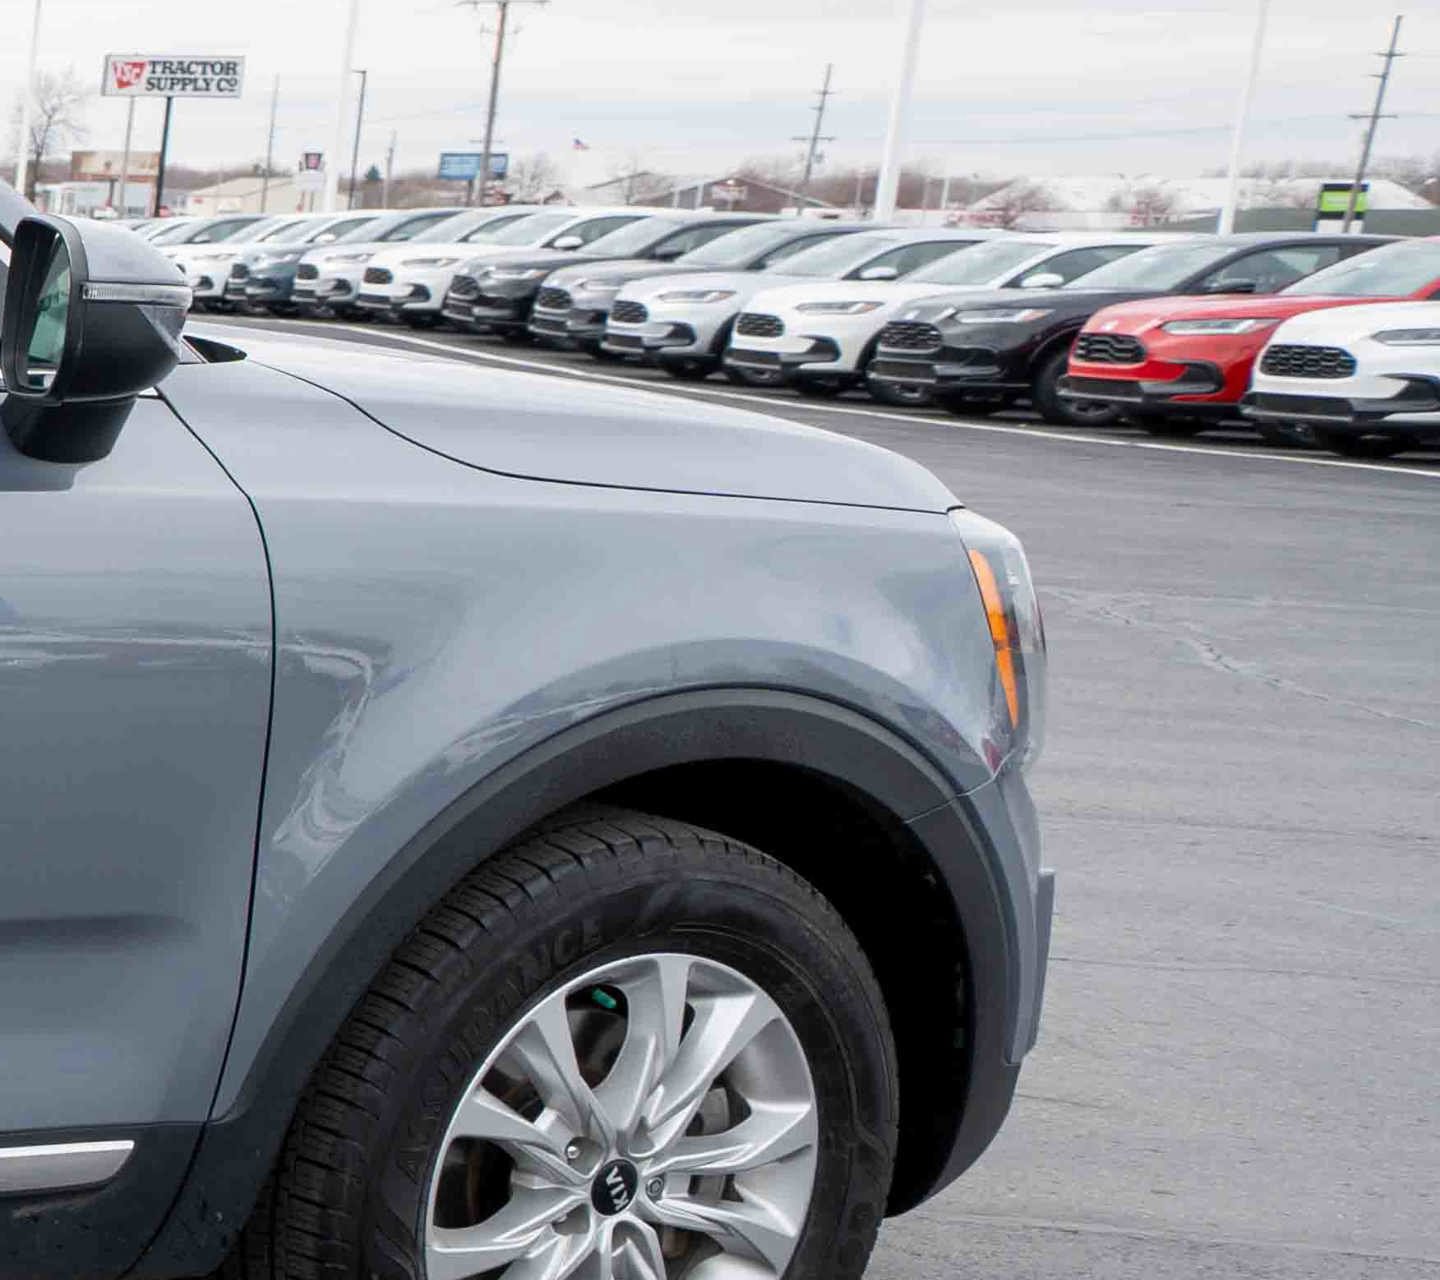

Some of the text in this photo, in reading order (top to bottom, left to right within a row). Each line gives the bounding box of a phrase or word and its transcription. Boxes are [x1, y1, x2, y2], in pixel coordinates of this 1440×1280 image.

[148, 60, 239, 76] TRACTOR
[145, 77, 214, 92] SUPPLY
[606, 1165, 629, 1211] KIA
